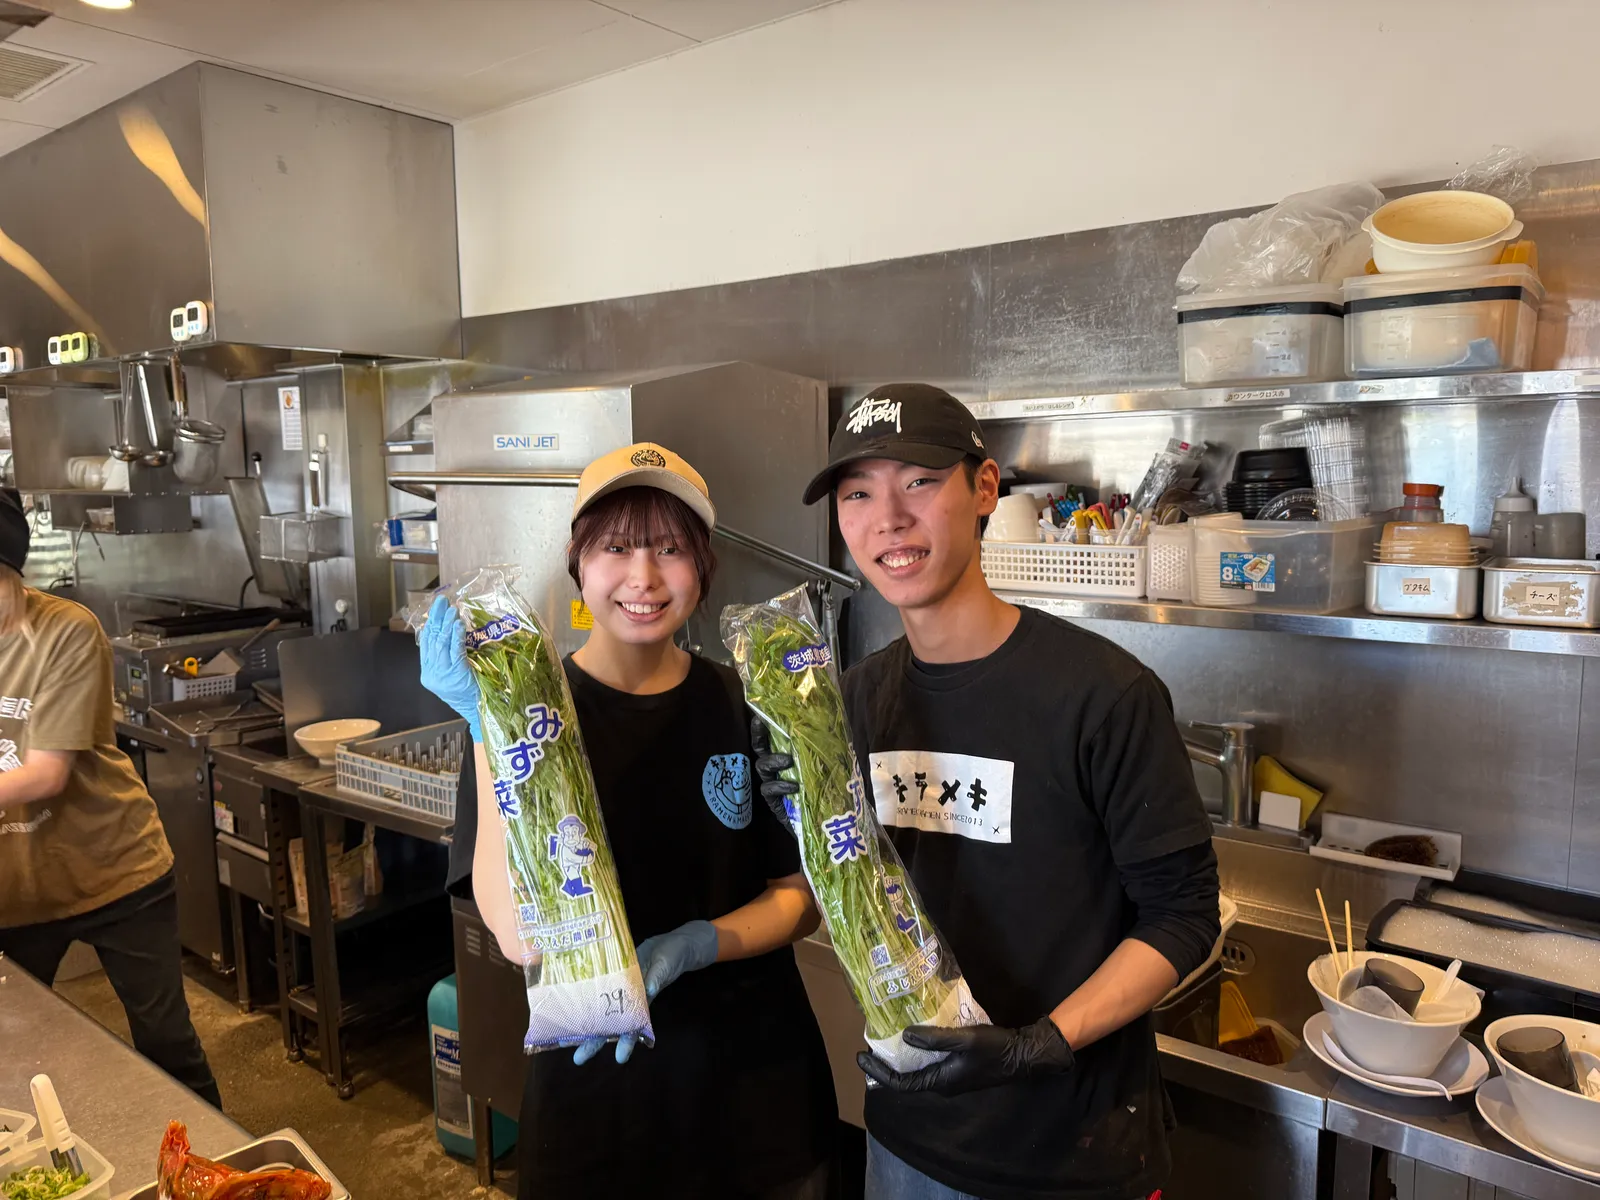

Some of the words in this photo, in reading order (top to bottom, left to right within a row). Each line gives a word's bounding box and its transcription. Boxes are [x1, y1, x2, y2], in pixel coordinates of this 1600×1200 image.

[496, 436, 531, 448] SANI
[533, 436, 556, 448] JET
[1529, 590, 1558, 602] チーズ
[892, 771, 988, 812] キラメキ
[600, 988, 626, 1017] 29
